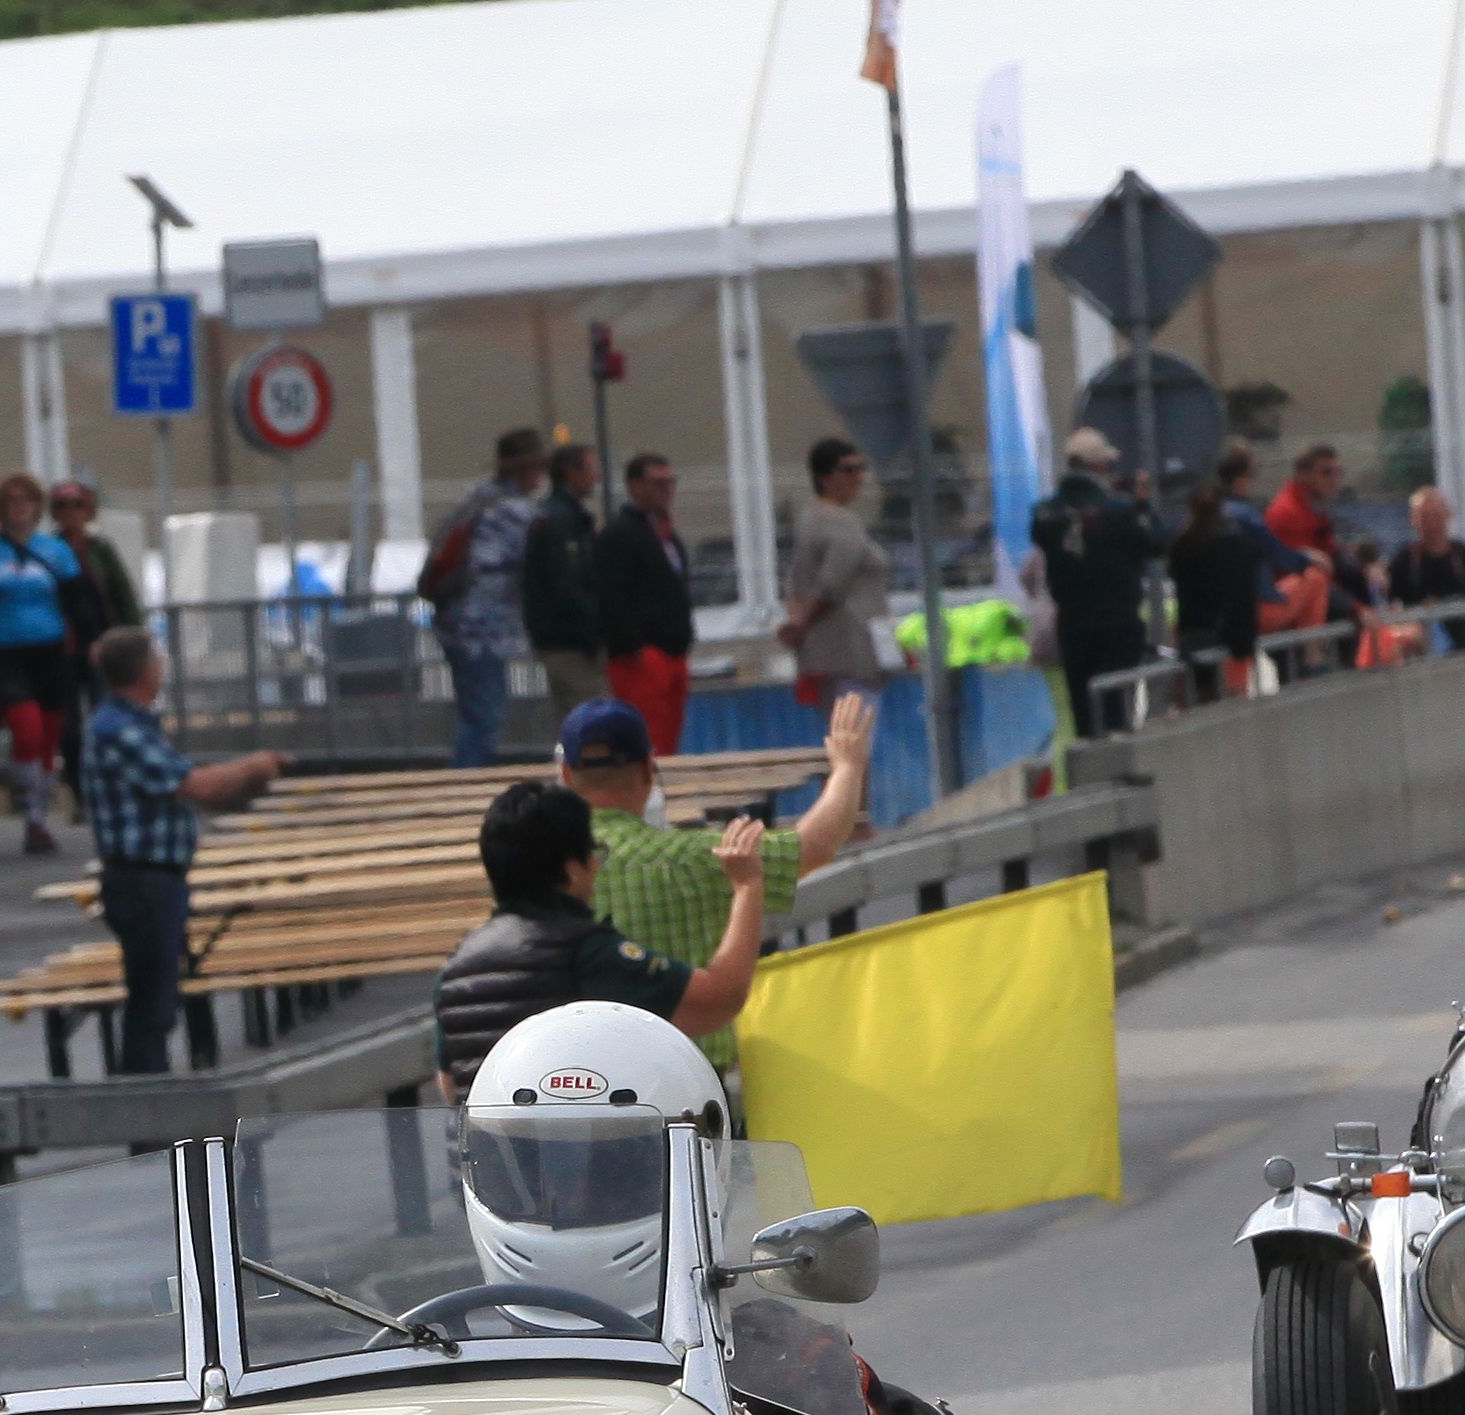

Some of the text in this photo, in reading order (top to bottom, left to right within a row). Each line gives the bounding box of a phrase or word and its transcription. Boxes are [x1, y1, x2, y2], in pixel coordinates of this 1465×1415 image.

[132, 301, 168, 354] P
[270, 380, 308, 418] 50
[550, 1076, 597, 1090] BELL
